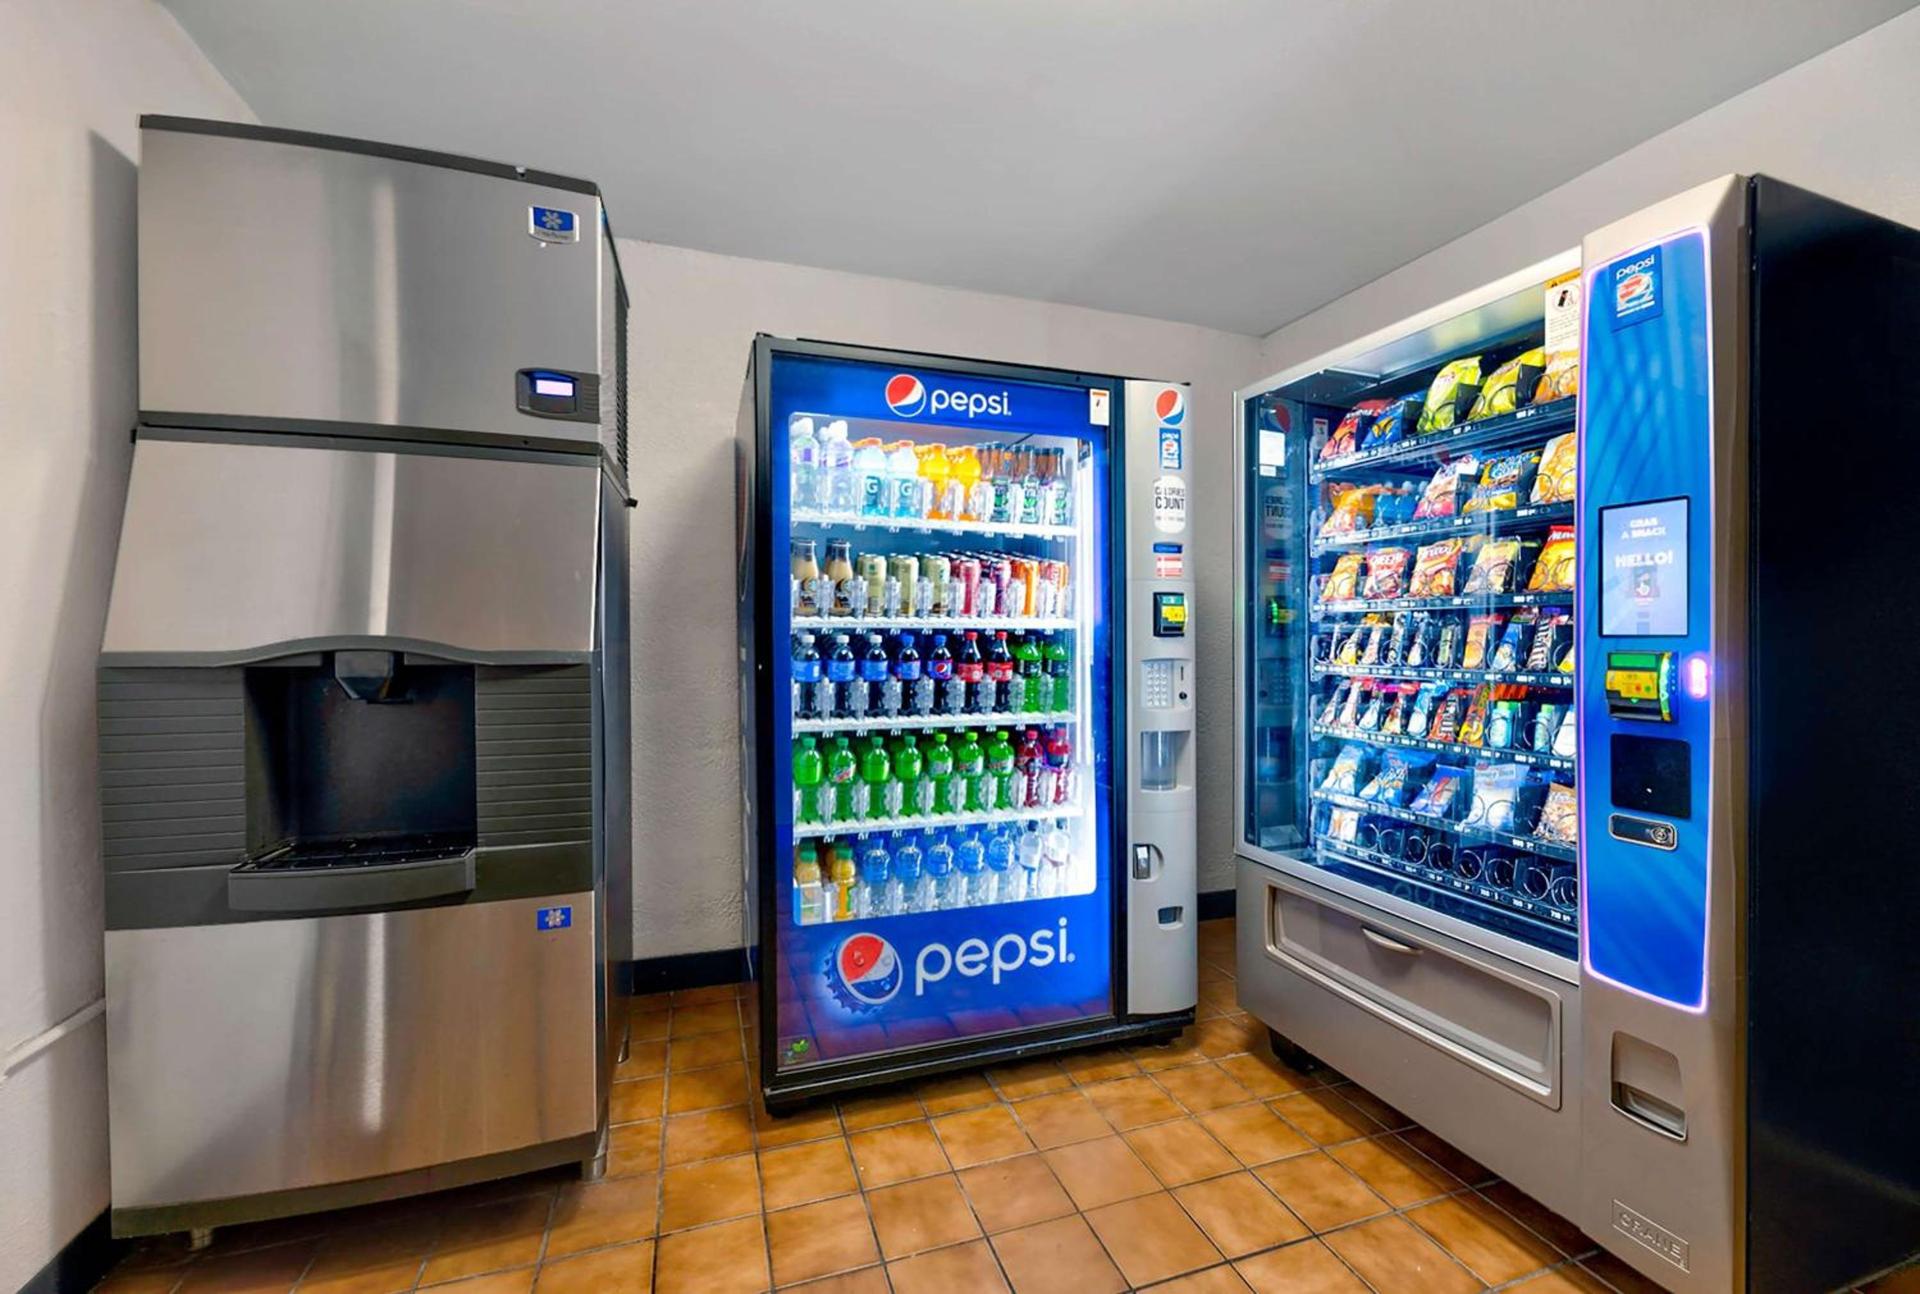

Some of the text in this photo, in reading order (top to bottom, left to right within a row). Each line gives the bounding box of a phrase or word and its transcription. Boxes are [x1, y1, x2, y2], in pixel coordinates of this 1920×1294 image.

[1616, 254, 1655, 280] pepsi
[931, 389, 1009, 418] pepsi
[1614, 548, 1674, 569] HELLO!
[915, 917, 1068, 996] pepsi
